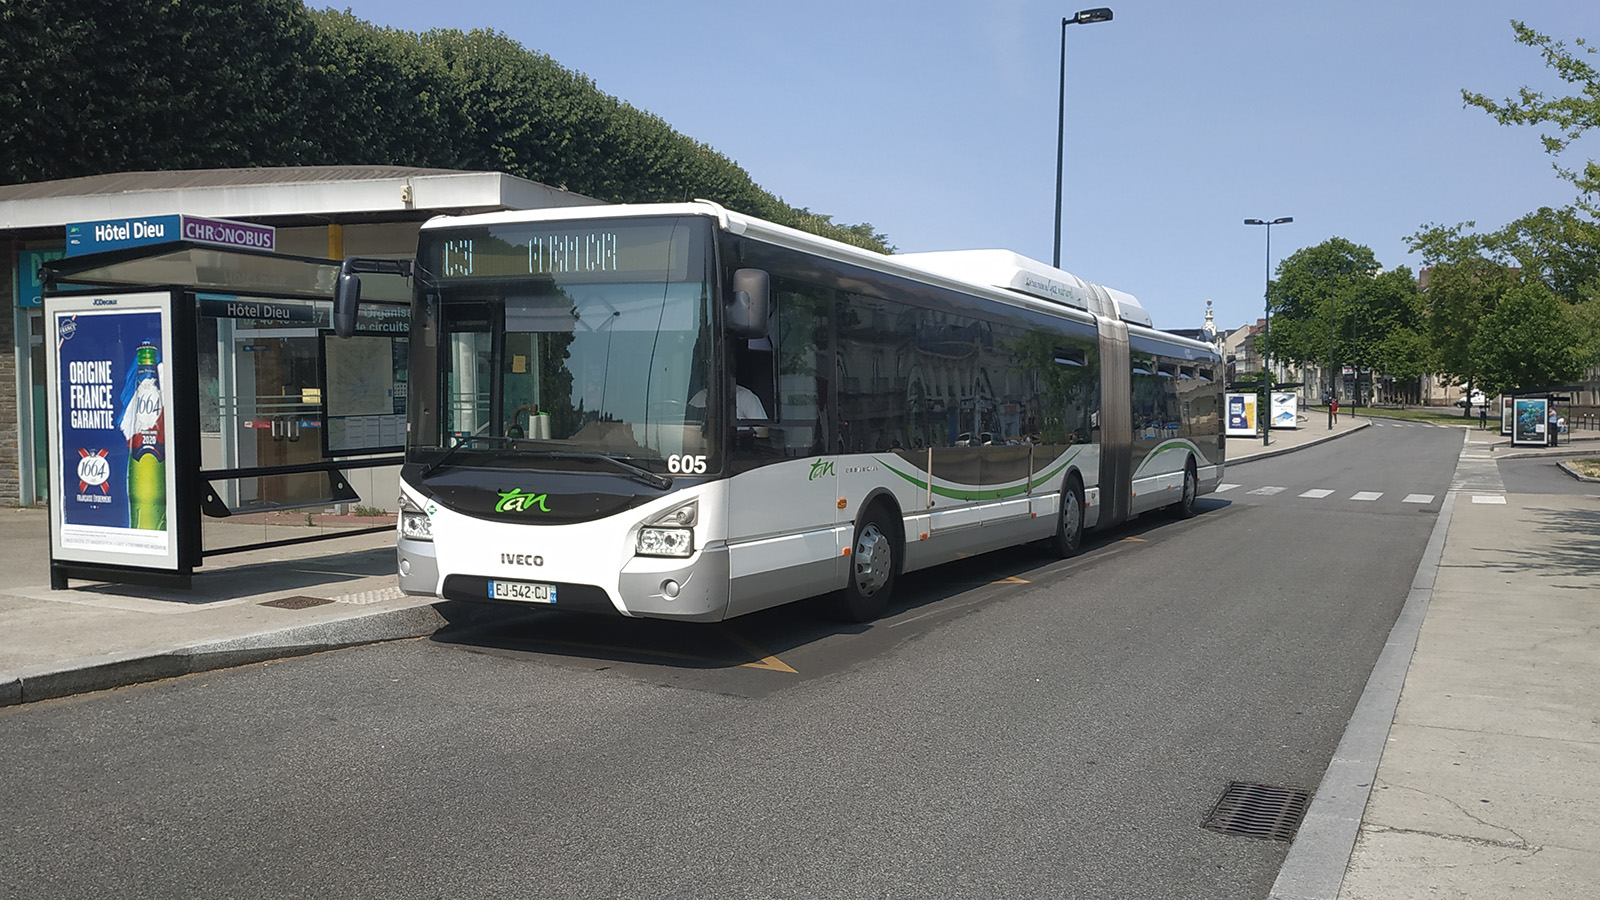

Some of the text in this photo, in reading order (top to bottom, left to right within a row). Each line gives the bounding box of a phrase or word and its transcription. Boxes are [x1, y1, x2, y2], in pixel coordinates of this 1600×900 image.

[95, 222, 130, 242] Hôtel
[133, 220, 165, 239] Dieu
[186, 222, 271, 248] CHRONOBUS
[227, 303, 290, 319] Hôtel Dieu
[369, 321, 410, 332] circuits
[69, 361, 113, 384] ORIGINE
[70, 385, 114, 410] FRANCE
[136, 394, 162, 416] 1664
[70, 409, 115, 430] GARANTIE
[80, 459, 107, 479] 1664
[667, 454, 707, 474] 605
[808, 457, 836, 481] tan
[494, 487, 552, 513] tan
[500, 553, 544, 567] IVECO
[496, 583, 548, 600] EJ-542-CJ
